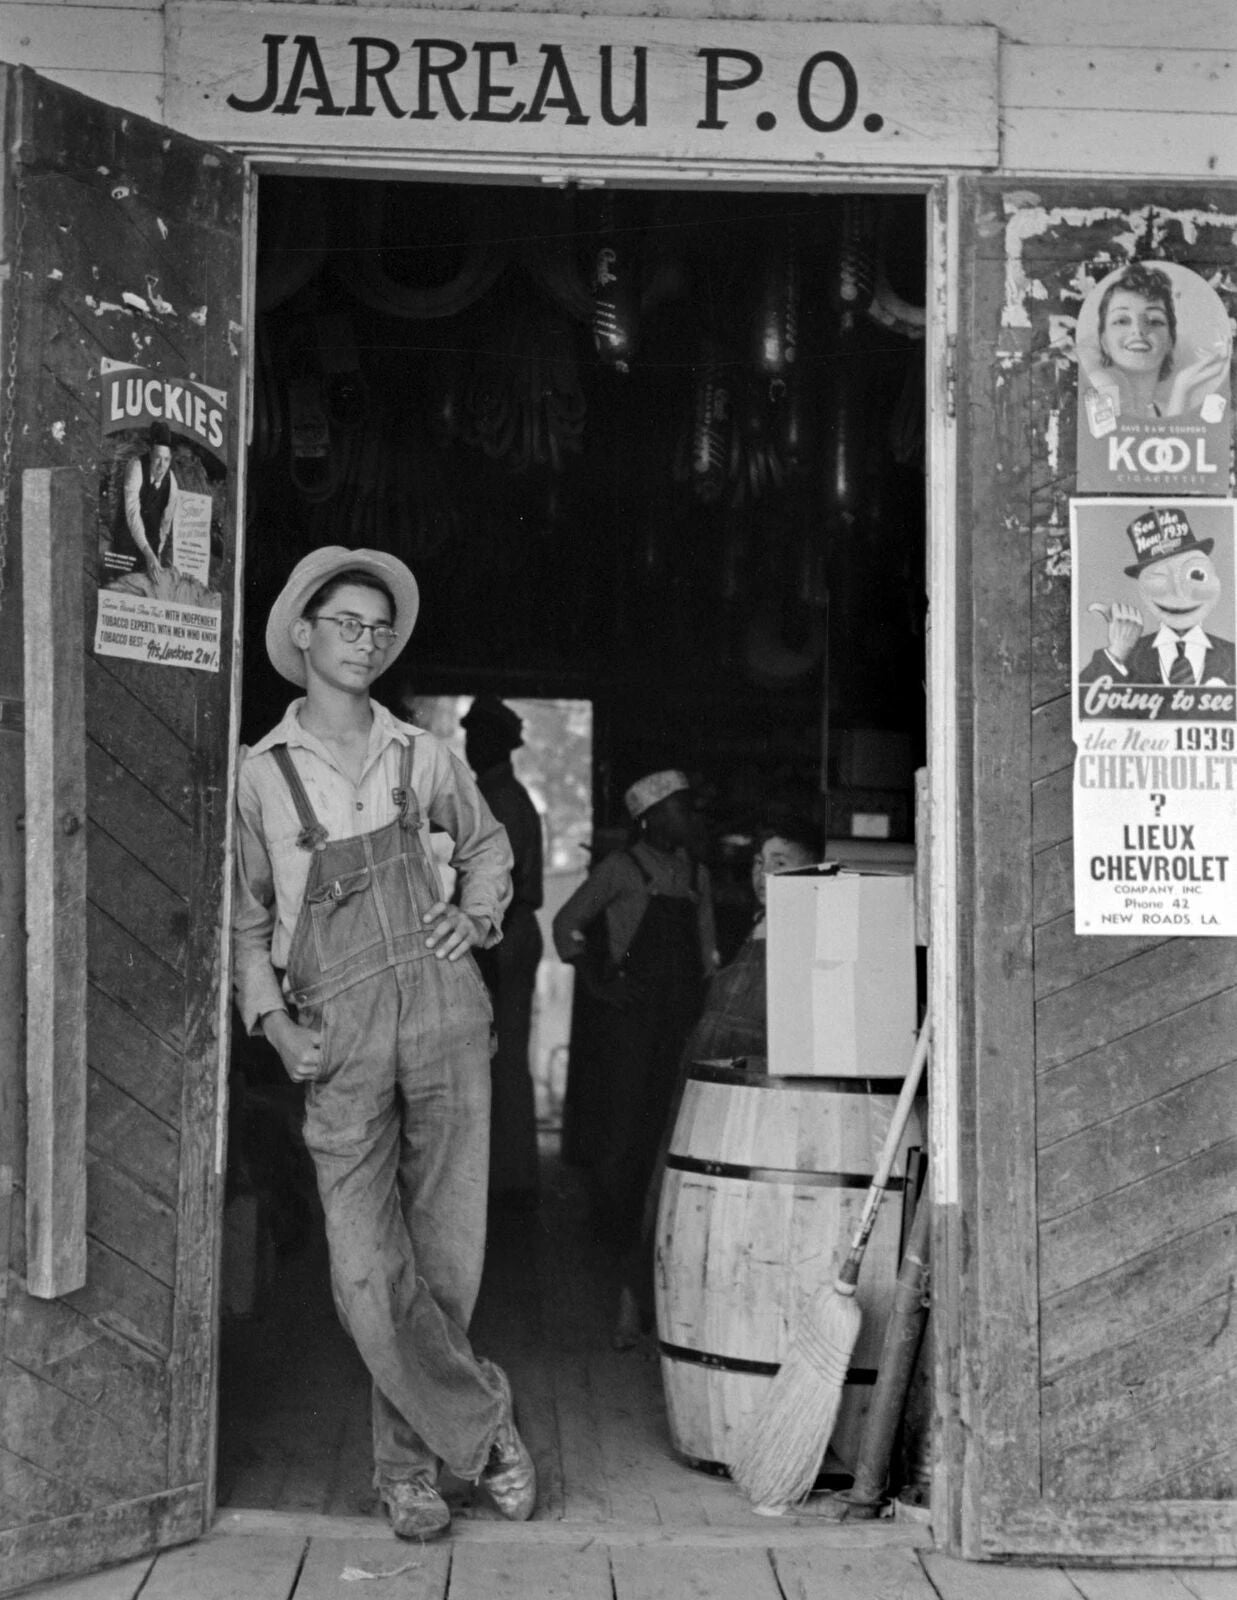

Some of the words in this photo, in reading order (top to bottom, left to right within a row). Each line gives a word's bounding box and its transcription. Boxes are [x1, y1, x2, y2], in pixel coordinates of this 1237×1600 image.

[226, 34, 648, 127] JARREAU
[110, 379, 223, 447] LUCKIES
[1108, 436, 1218, 473] KOOL
[1133, 520, 1155, 537] See
[1159, 511, 1179, 525] the
[1136, 533, 1161, 553] New
[1163, 522, 1188, 540] 1939
[102, 614, 129, 630] TOBACCO
[157, 623, 172, 636] WITH
[173, 626, 185, 638] MEN
[186, 628, 200, 641] WHO
[201, 631, 217, 643] KNOW
[165, 609, 180, 622] WITH
[181, 611, 217, 627] INDEPENDENT
[100, 630, 128, 646] TOBACCO
[159, 640, 194, 662] Luckies
[194, 647, 204, 664] 2
[1084, 675, 1164, 719] Going
[1171, 689, 1195, 710] to
[1198, 693, 1234, 711] see
[1084, 728, 1117, 750] the
[1122, 727, 1170, 750] New
[1175, 727, 1235, 751] 1939
[1079, 755, 1237, 790] CHEVROLET
[1150, 793, 1166, 817] ?
[1124, 825, 1195, 850] LIEUX
[1090, 856, 1229, 881] CHEVROLET
[1114, 885, 1174, 895] COMPANY
[1125, 898, 1164, 909] Phone
[1172, 899, 1190, 909] 42
[1101, 914, 1133, 924] NEW
